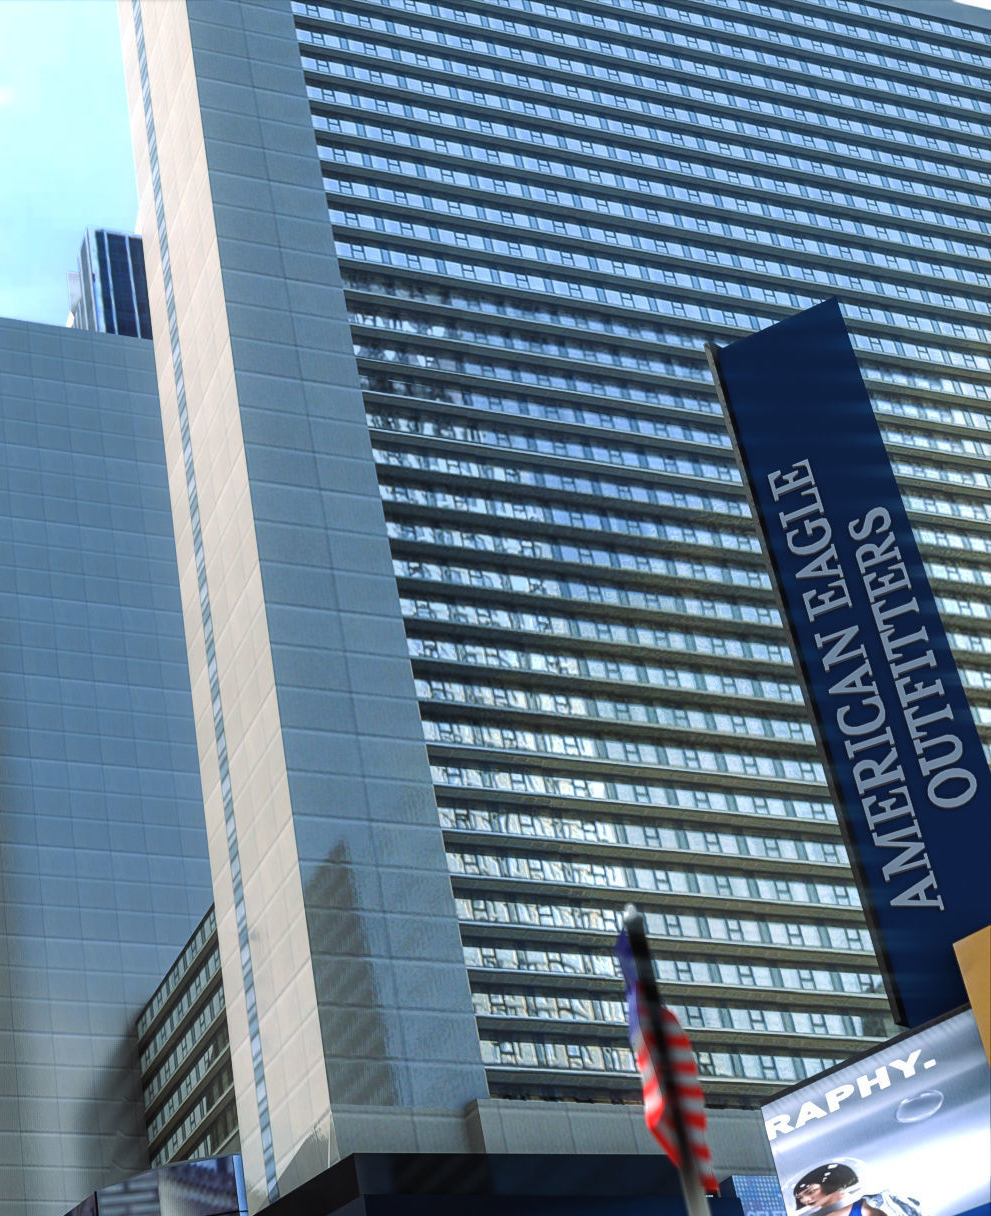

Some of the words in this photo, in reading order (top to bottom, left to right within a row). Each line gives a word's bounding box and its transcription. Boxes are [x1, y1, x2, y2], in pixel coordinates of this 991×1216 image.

[767, 459, 854, 623] EAGLE
[848, 507, 978, 809] OUTFITTERS
[815, 624, 945, 913] AMERICAN
